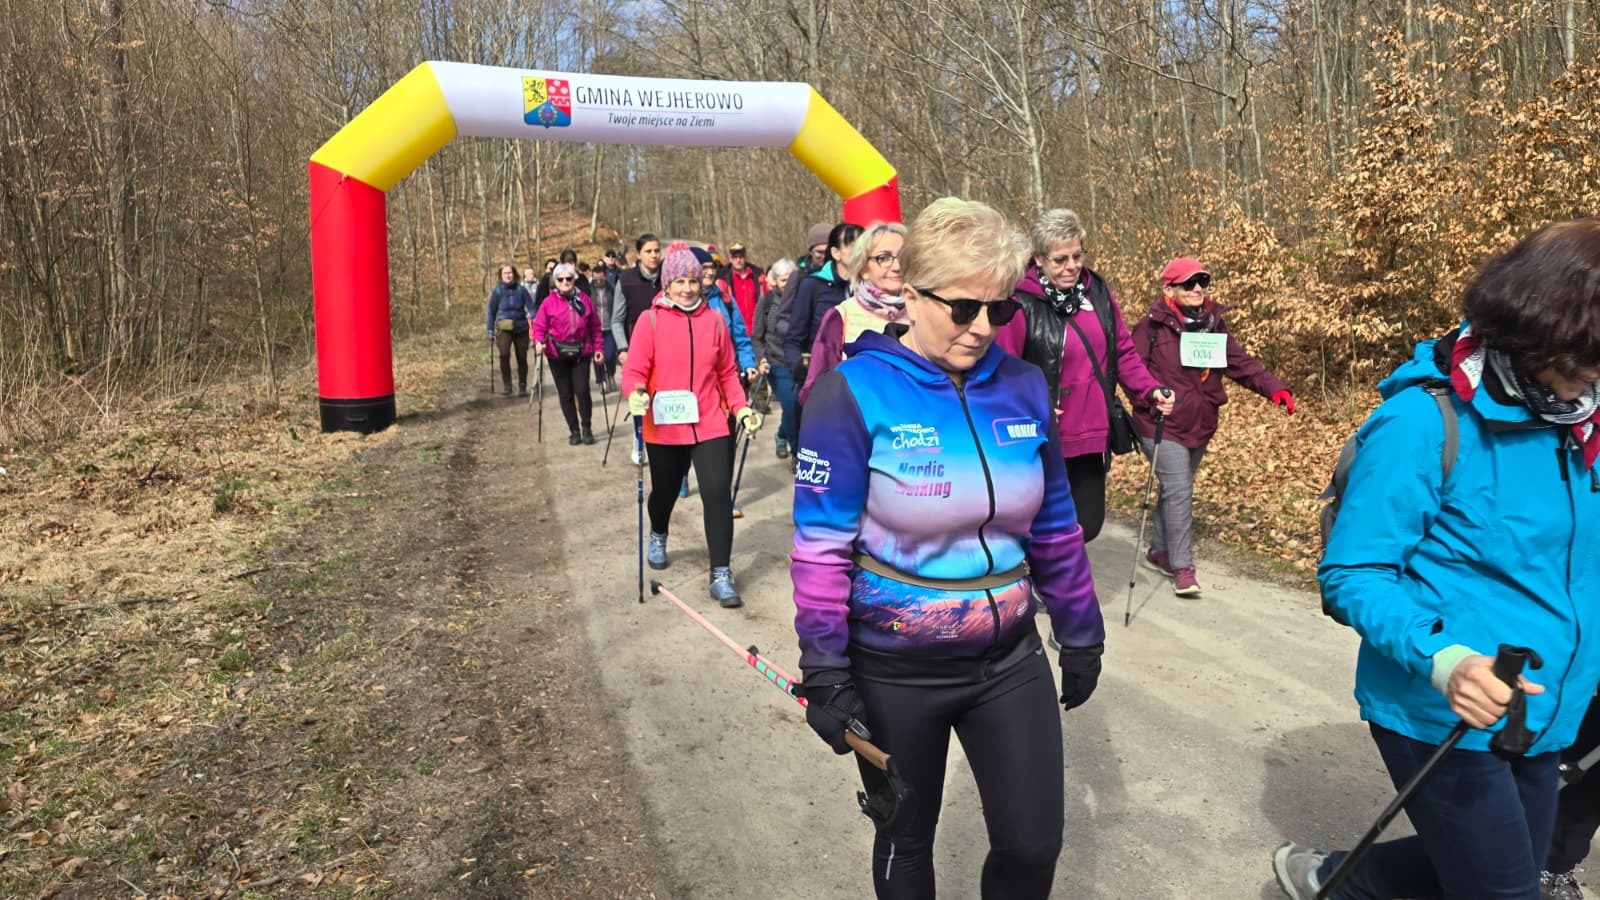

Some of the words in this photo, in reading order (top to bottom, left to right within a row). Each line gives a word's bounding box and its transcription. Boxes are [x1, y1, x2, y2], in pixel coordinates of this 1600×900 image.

[576, 86, 633, 107] GMINA
[637, 90, 744, 110] WEJHEROWO
[608, 112, 637, 127] Twoje
[638, 114, 674, 128] miejsce
[676, 117, 688, 127] na
[689, 115, 716, 128] Ziemi
[1193, 349, 1212, 360] 034
[664, 403, 685, 414] 009
[892, 432, 940, 450] Chodzi
[795, 461, 832, 485] hodzi
[898, 460, 945, 478] Nordic
